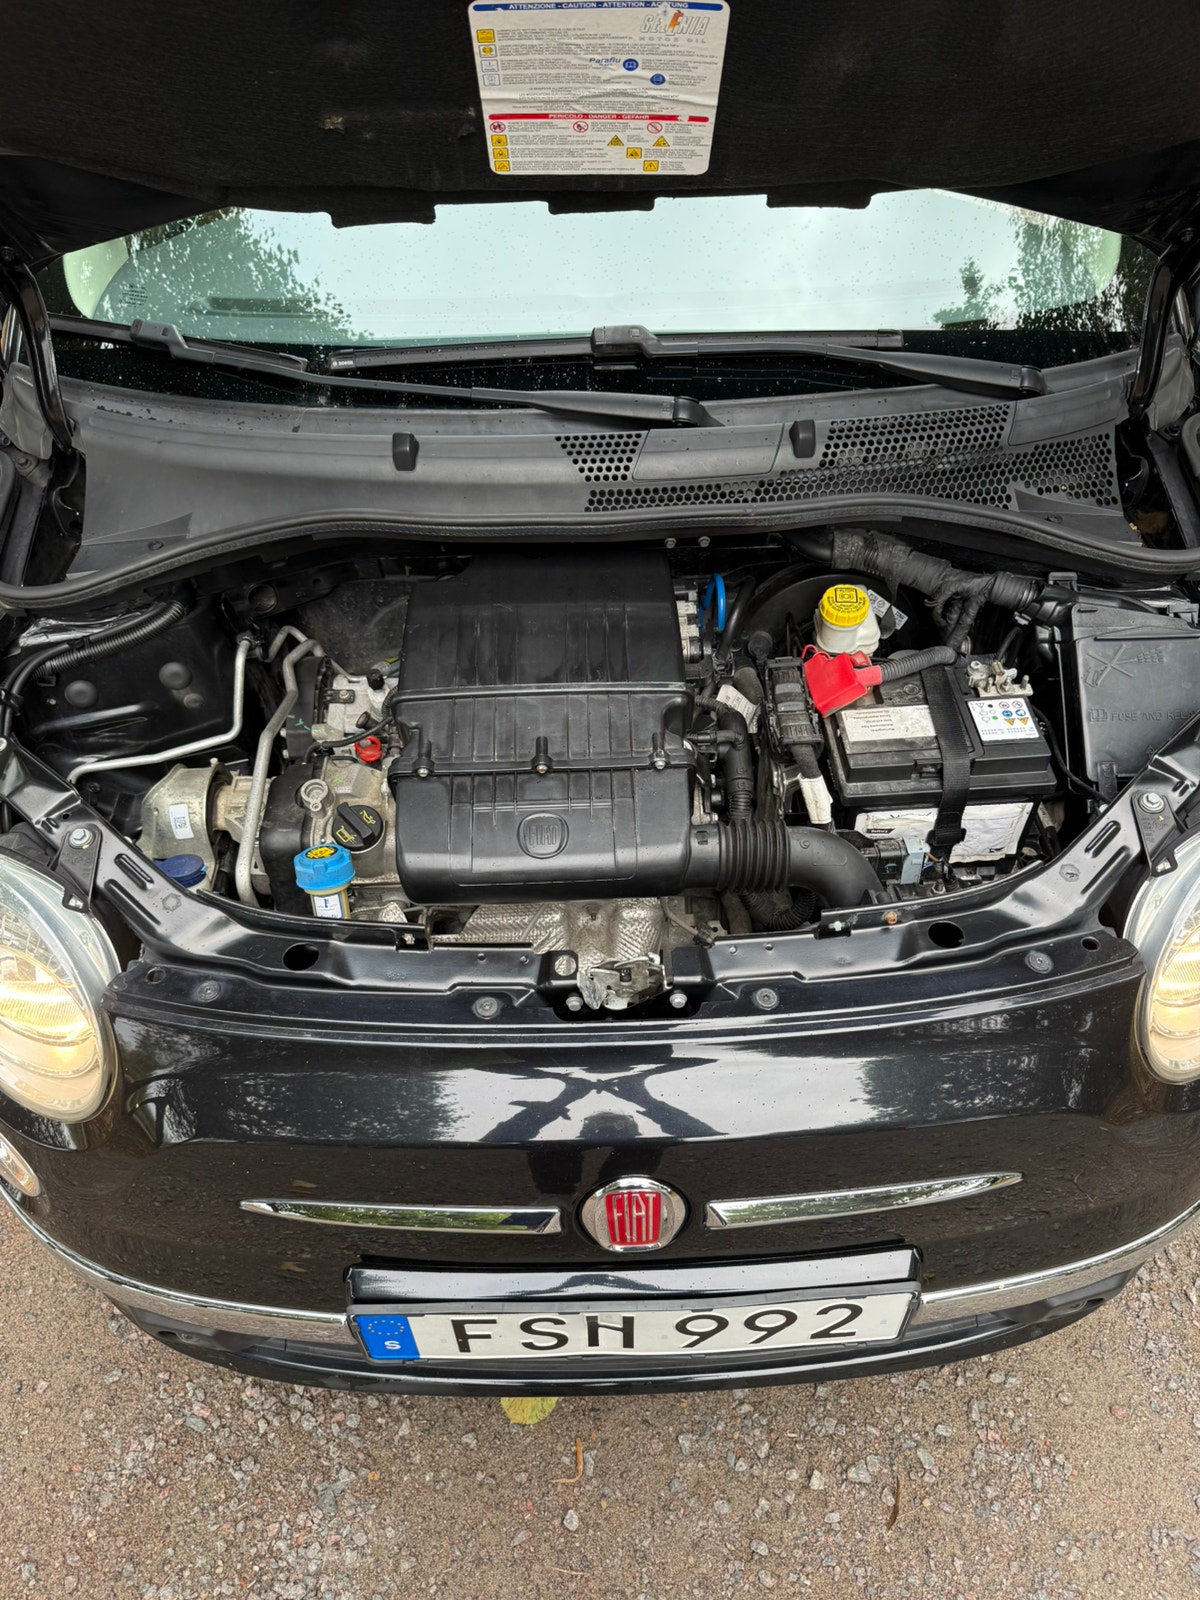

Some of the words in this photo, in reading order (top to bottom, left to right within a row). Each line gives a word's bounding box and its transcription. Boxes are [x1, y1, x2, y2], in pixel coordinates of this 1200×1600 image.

[1111, 711, 1137, 721] FUSE
[1142, 710, 1162, 721] AND
[612, 1193, 657, 1243] FIAT
[451, 1315, 635, 1351] FSH
[675, 1303, 863, 1348] 992
[384, 1340, 401, 1350] S
